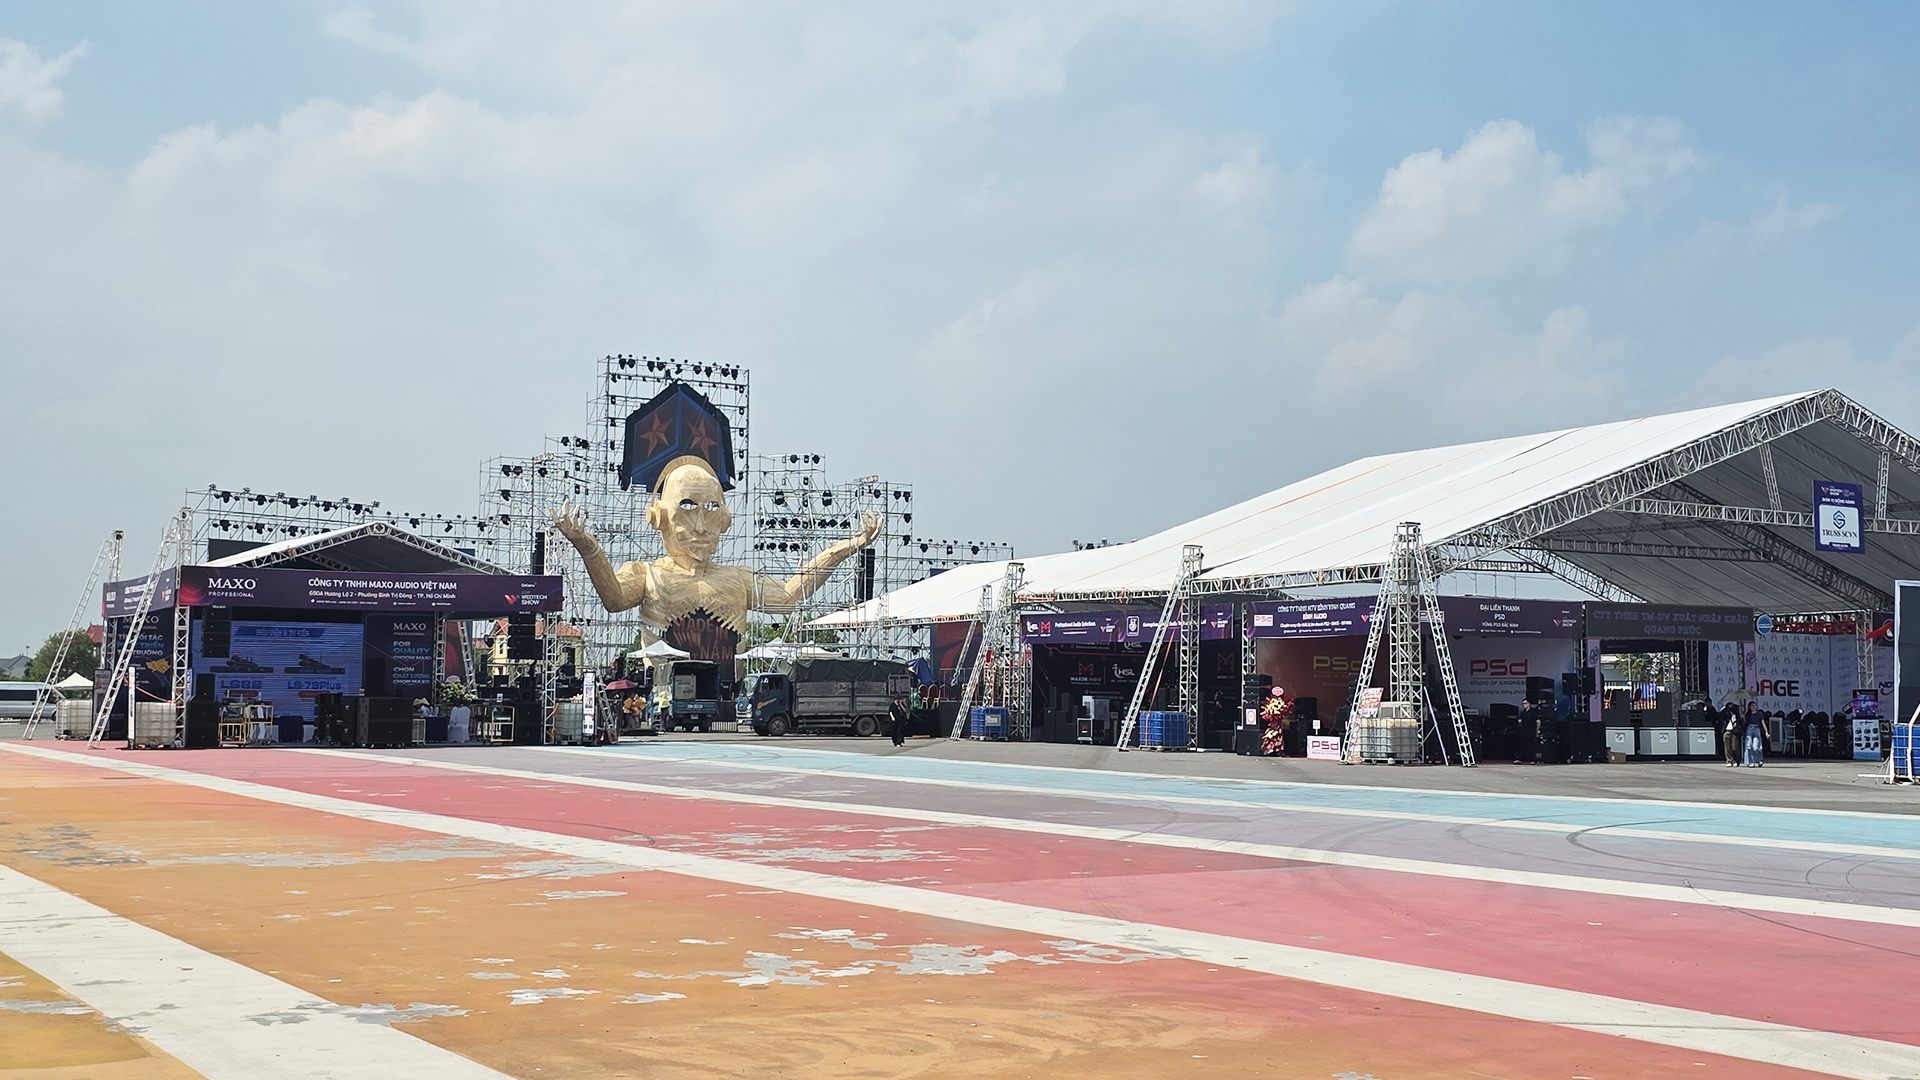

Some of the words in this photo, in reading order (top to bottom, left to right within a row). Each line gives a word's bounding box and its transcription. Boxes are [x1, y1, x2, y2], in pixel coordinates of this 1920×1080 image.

[208, 578, 256, 590] MAXO
[308, 577, 332, 587] CÔNG
[333, 580, 344, 588] TY
[345, 580, 368, 588] TNHH
[369, 580, 394, 589] MAXO
[394, 581, 420, 590] AUDIO
[420, 580, 438, 591] VIỆT
[438, 582, 457, 590] NAM
[1480, 604, 1490, 612] ĐẠI
[1614, 612, 1639, 620] TNHH
[1641, 612, 1670, 620] TM-DV
[394, 622, 426, 630] MAXO
[673, 618, 714, 633] MADE
[1644, 626, 1676, 634] QUANG
[1678, 626, 1702, 634] PHÚC
[716, 626, 728, 640] IN
[1470, 658, 1528, 676] PSd
[1312, 740, 1338, 750] PSd
